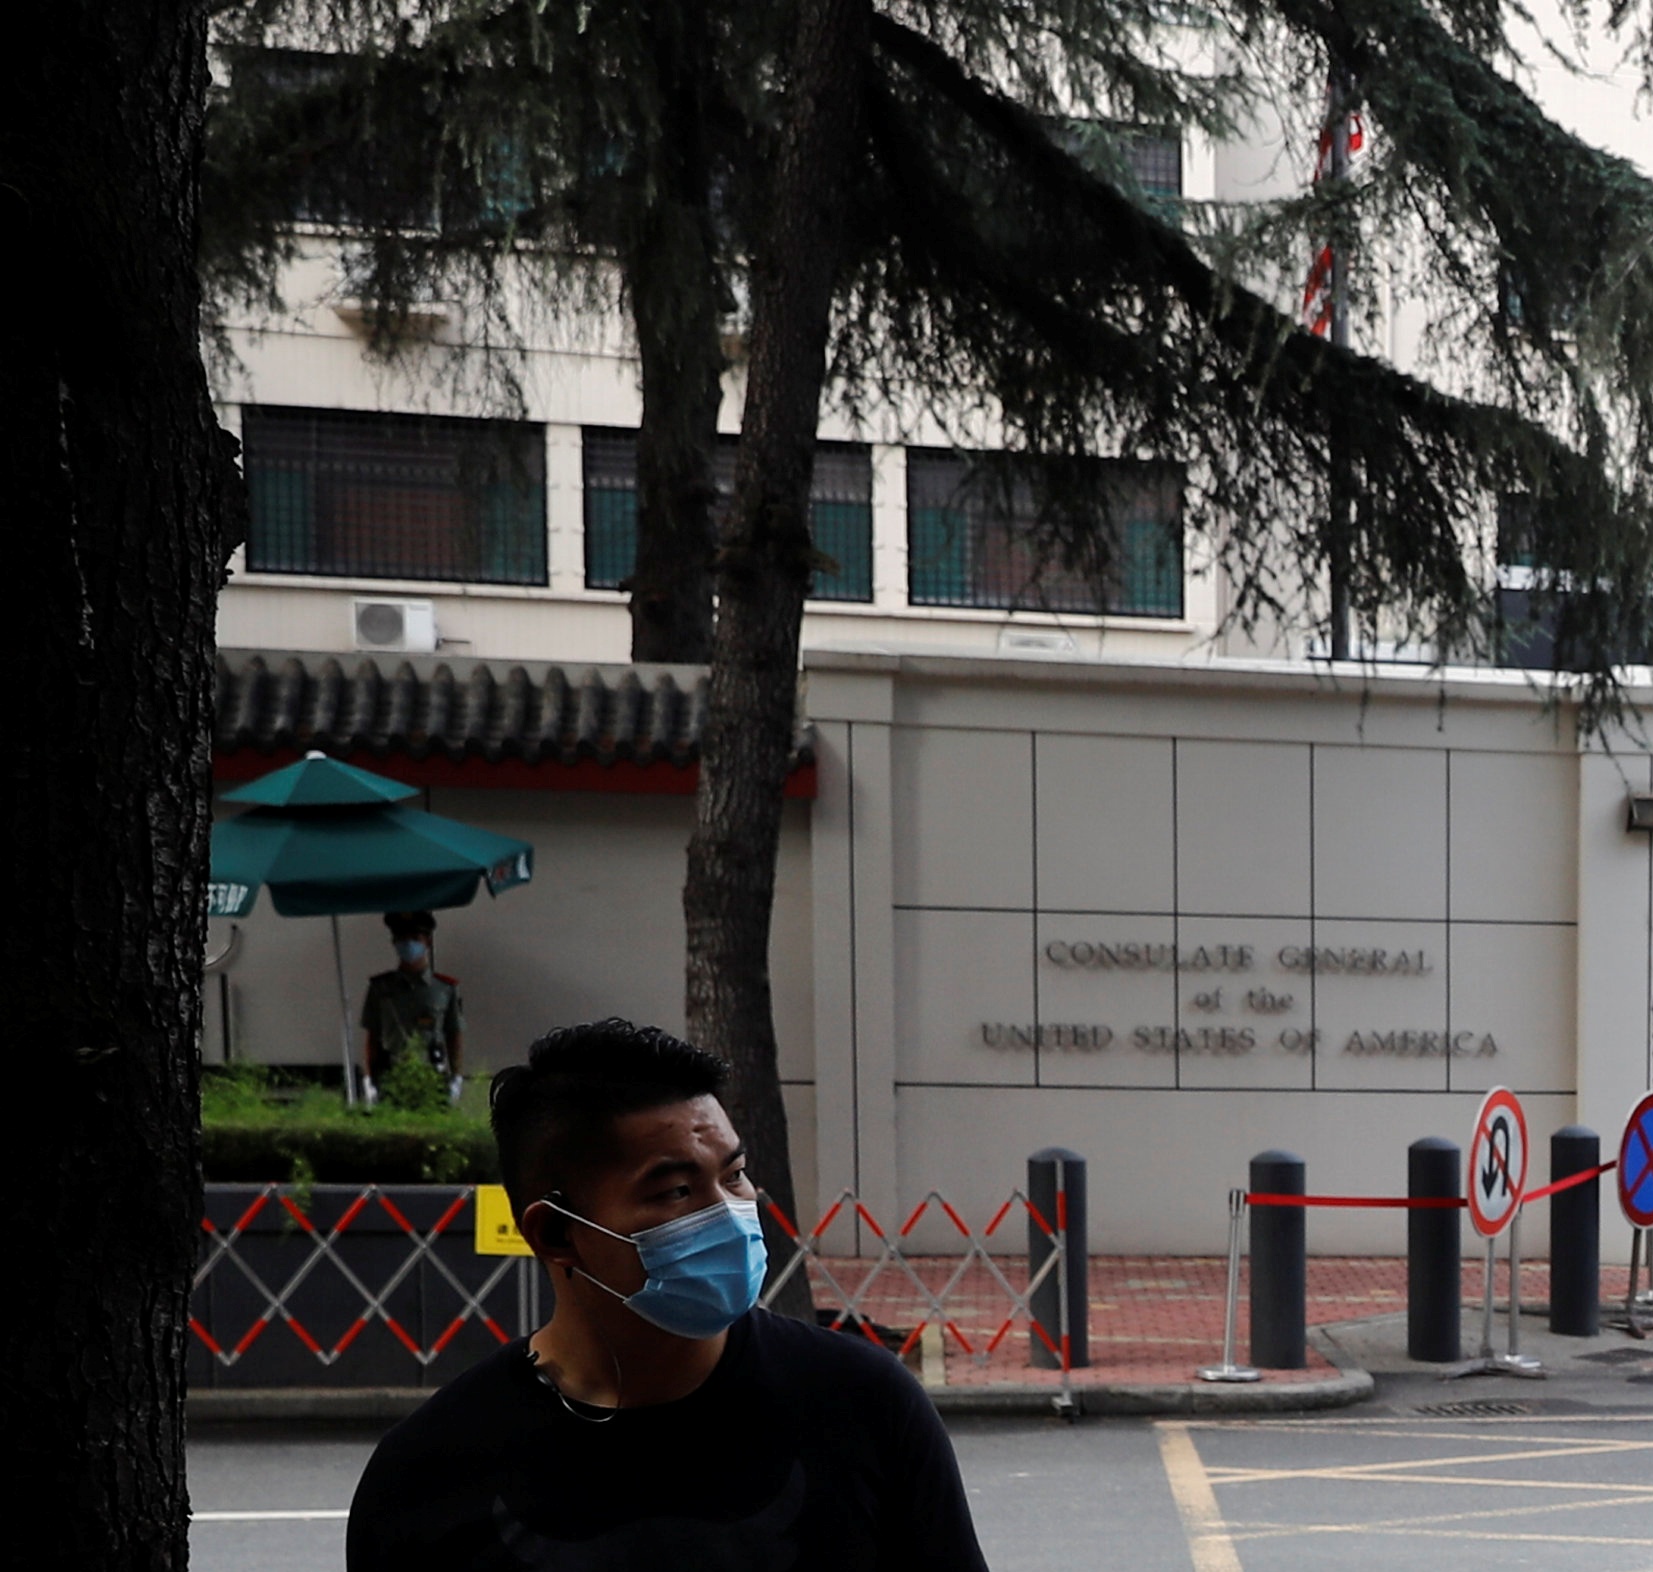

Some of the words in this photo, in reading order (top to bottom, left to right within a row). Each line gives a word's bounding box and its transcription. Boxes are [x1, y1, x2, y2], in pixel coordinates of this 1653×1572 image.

[1045, 940, 1255, 971] CONSULATE
[1277, 945, 1432, 974] GENERAL
[1193, 986, 1222, 1011] of
[1246, 987, 1294, 1012] the
[980, 1022, 1114, 1050] UNITED
[1132, 1024, 1255, 1052] STATES
[1278, 1027, 1320, 1053] OF
[1345, 1028, 1498, 1056] AMERICA
